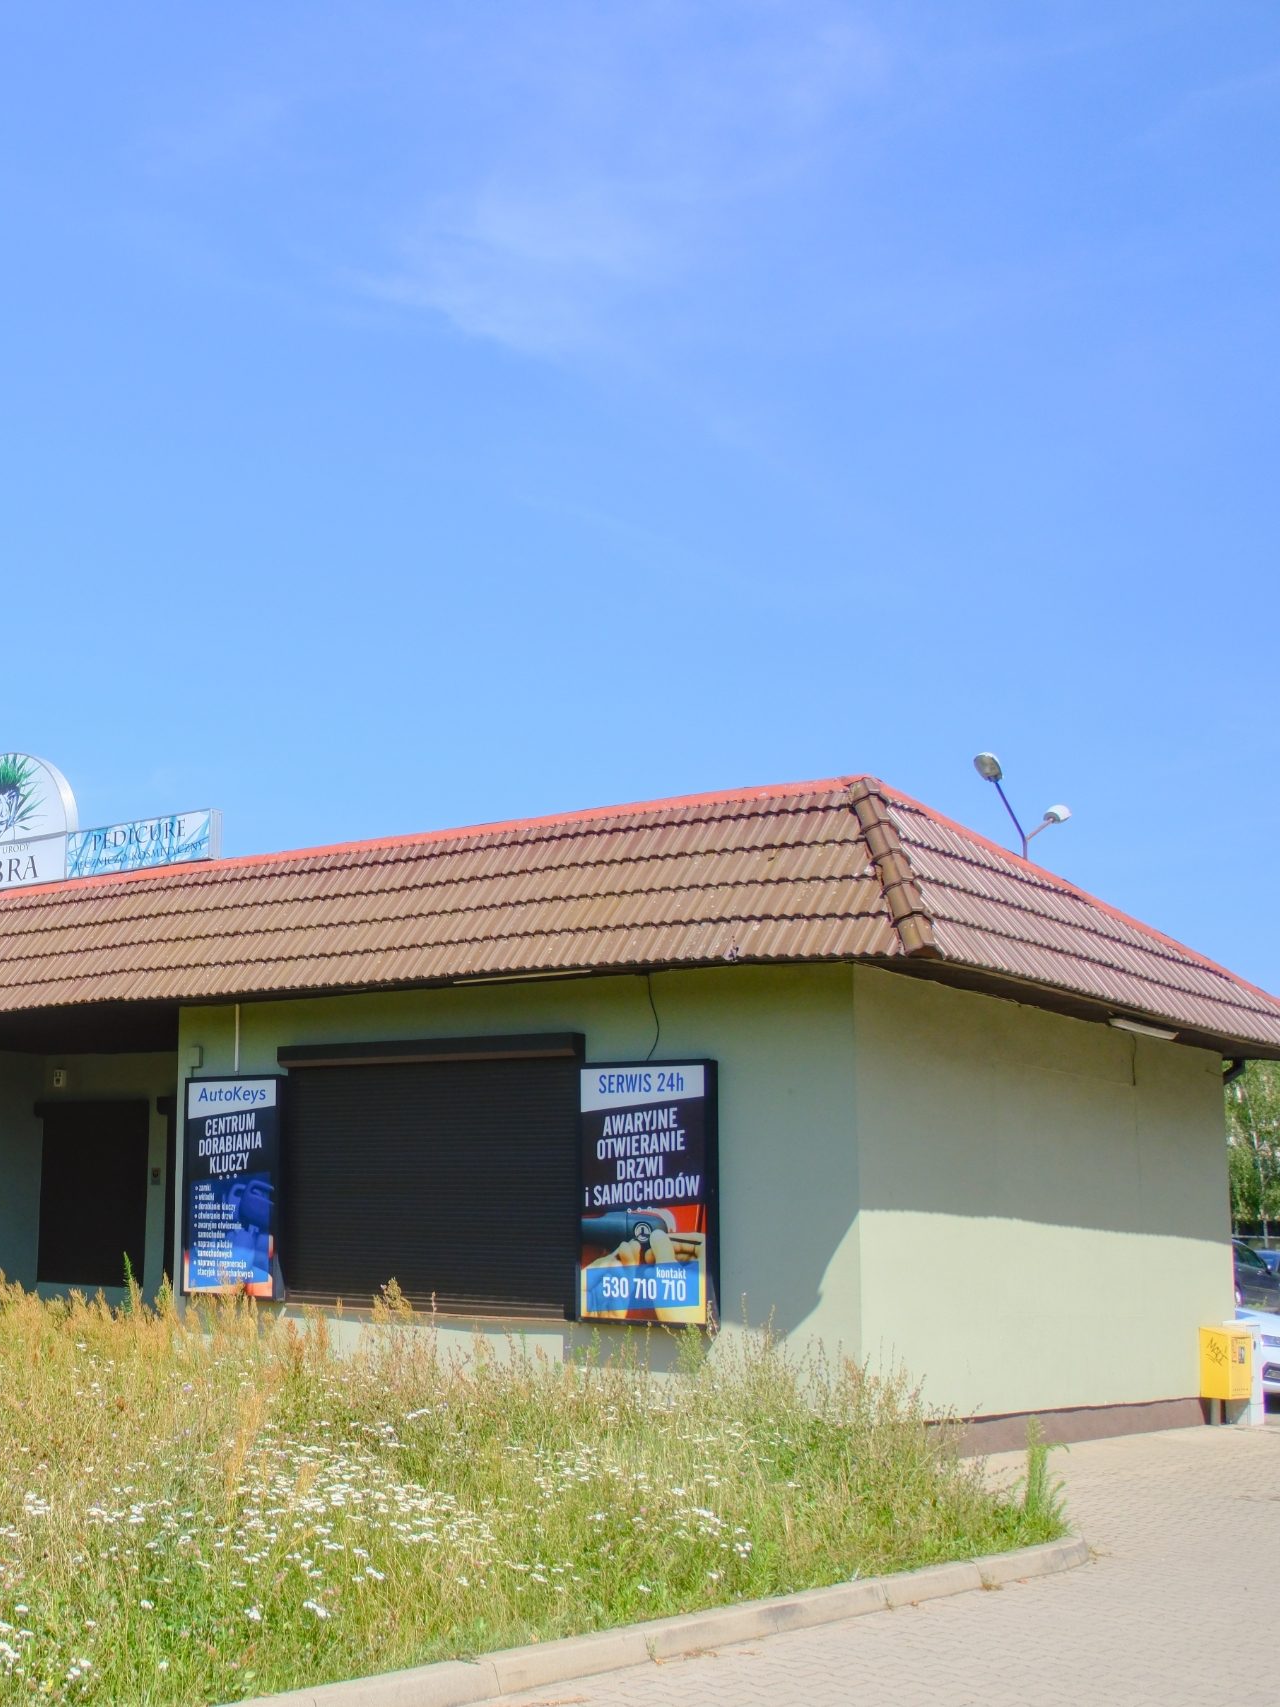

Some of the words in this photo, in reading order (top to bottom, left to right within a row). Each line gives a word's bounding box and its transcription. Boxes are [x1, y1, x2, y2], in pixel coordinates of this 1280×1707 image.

[93, 819, 186, 850] PEDICURE
[198, 1086, 266, 1104] AutoKeys
[598, 1073, 652, 1094] SERWIS
[657, 1072, 684, 1092] 24h
[205, 1112, 255, 1137] CENTRUM
[602, 1107, 678, 1137] AWARYJNE
[198, 1131, 262, 1157] DORABIANIA
[596, 1129, 686, 1160] OTWIERANIE
[209, 1152, 249, 1174] KLUCZY
[616, 1155, 664, 1181] DRZWI
[585, 1186, 589, 1207] i
[593, 1173, 700, 1206] SAMOCHODÓW
[656, 1267, 687, 1279] kontakt
[602, 1276, 629, 1298] 530
[633, 1278, 657, 1299] 710
[662, 1279, 686, 1301] 710
